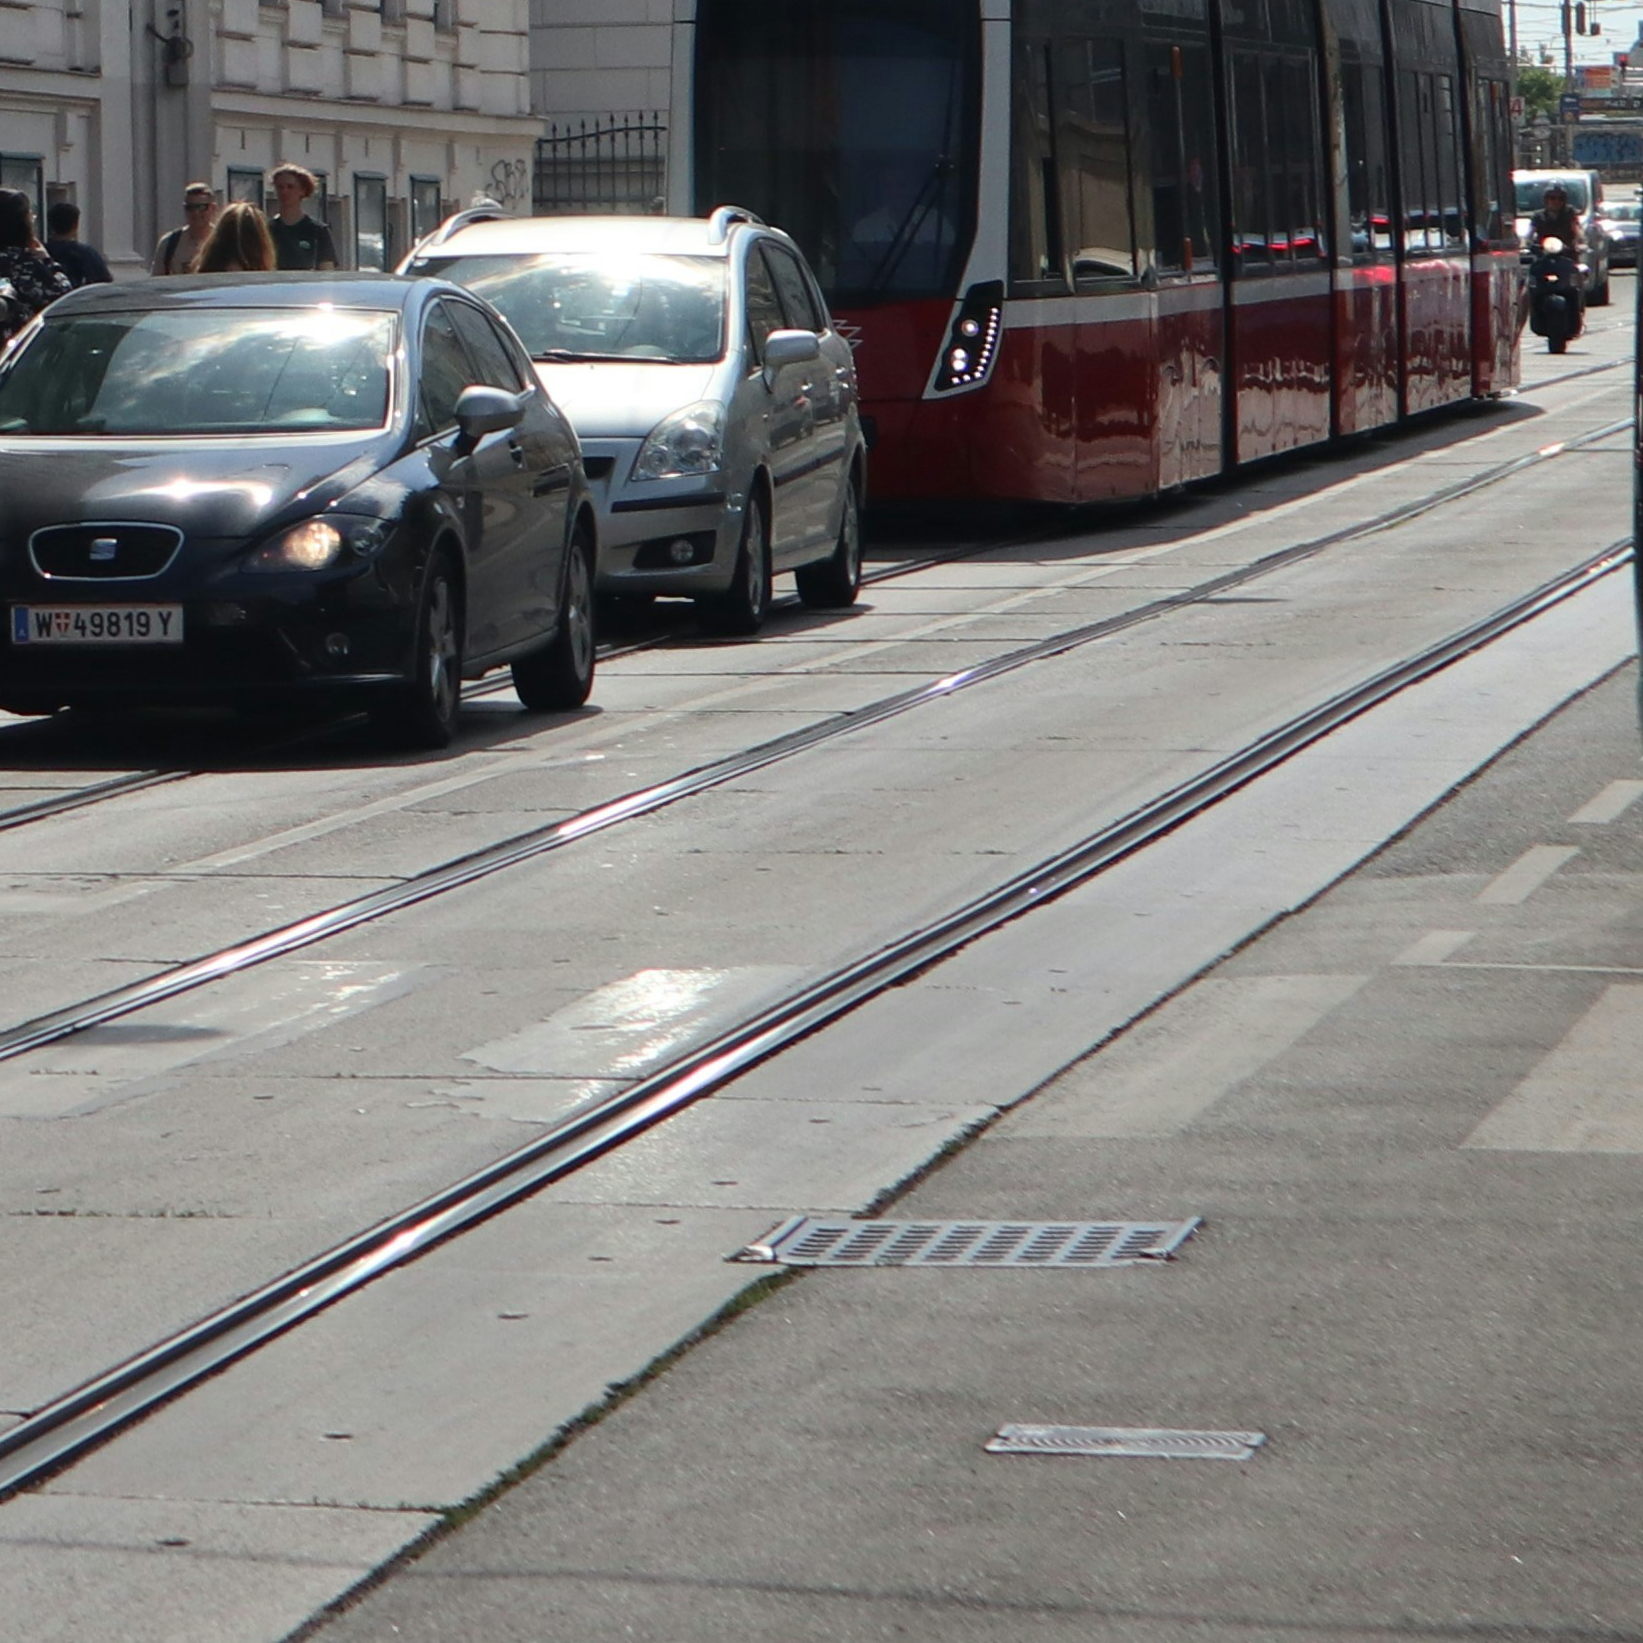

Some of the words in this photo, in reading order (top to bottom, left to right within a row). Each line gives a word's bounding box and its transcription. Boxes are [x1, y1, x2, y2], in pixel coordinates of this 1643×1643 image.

[35, 611, 53, 638] W
[73, 611, 151, 638] 49819
[157, 610, 173, 637] Y
